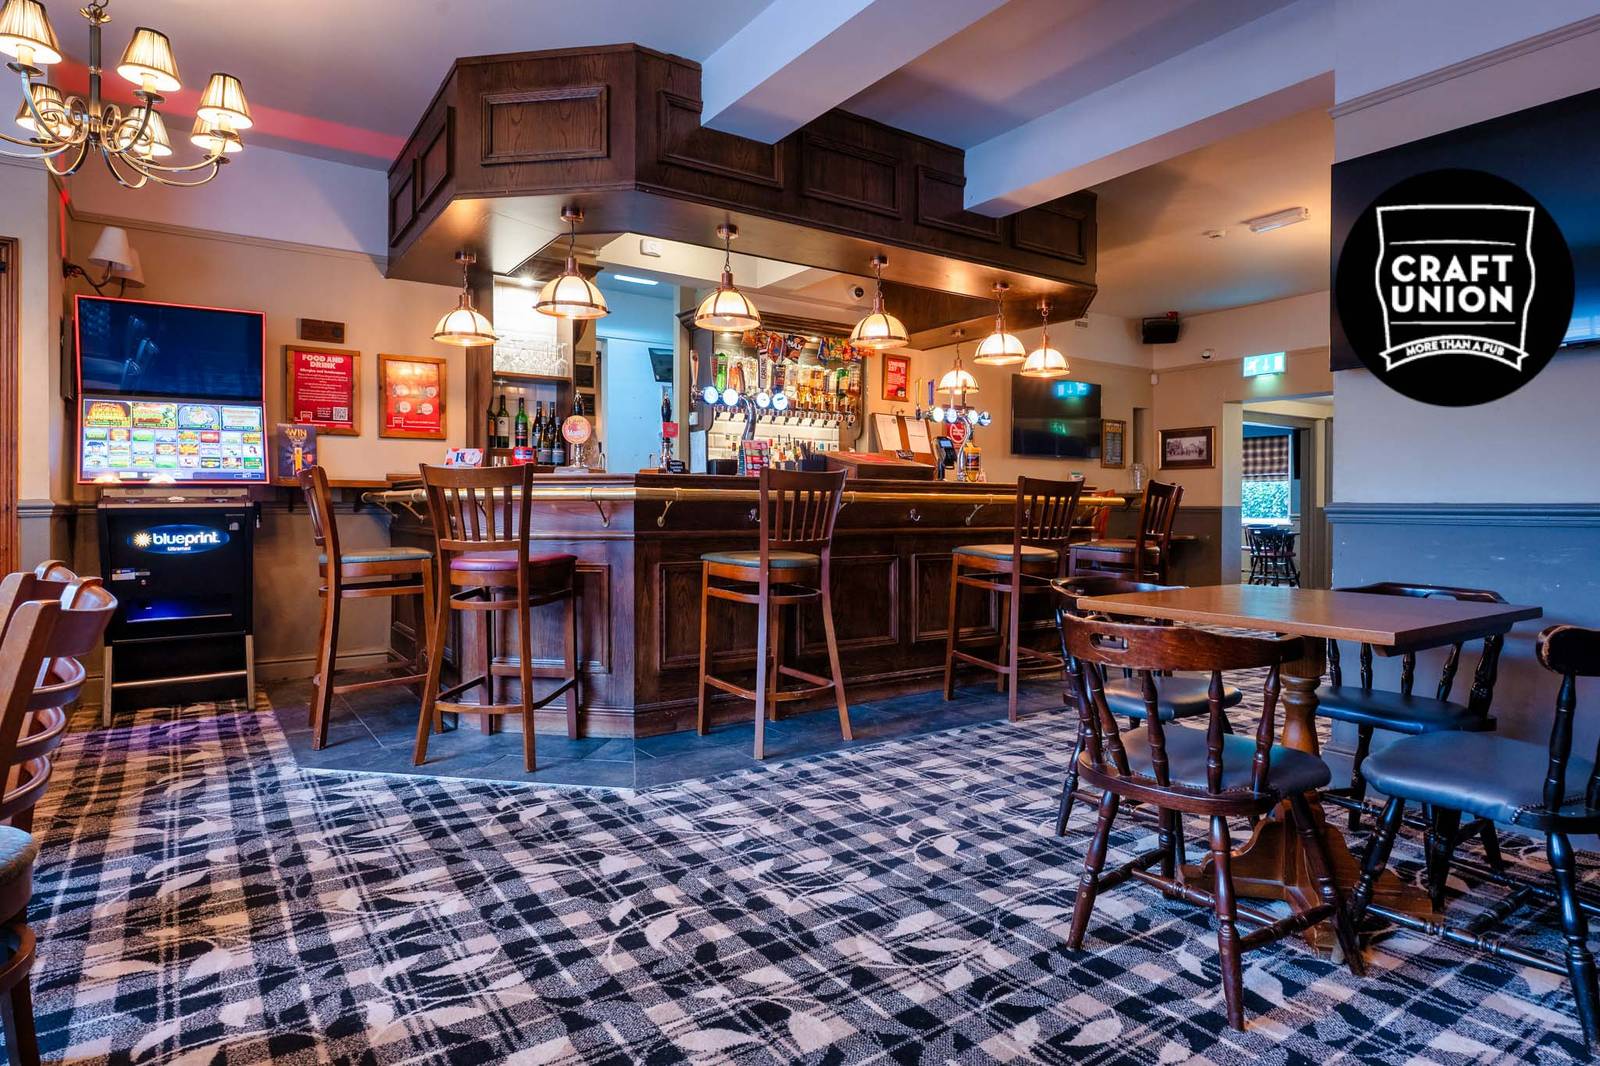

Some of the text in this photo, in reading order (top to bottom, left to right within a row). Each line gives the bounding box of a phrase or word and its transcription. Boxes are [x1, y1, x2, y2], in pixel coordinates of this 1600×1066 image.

[302, 354, 326, 362] FOOD
[310, 361, 336, 369] DRINK
[287, 428, 307, 438] WIN
[152, 531, 219, 546] blueprint
